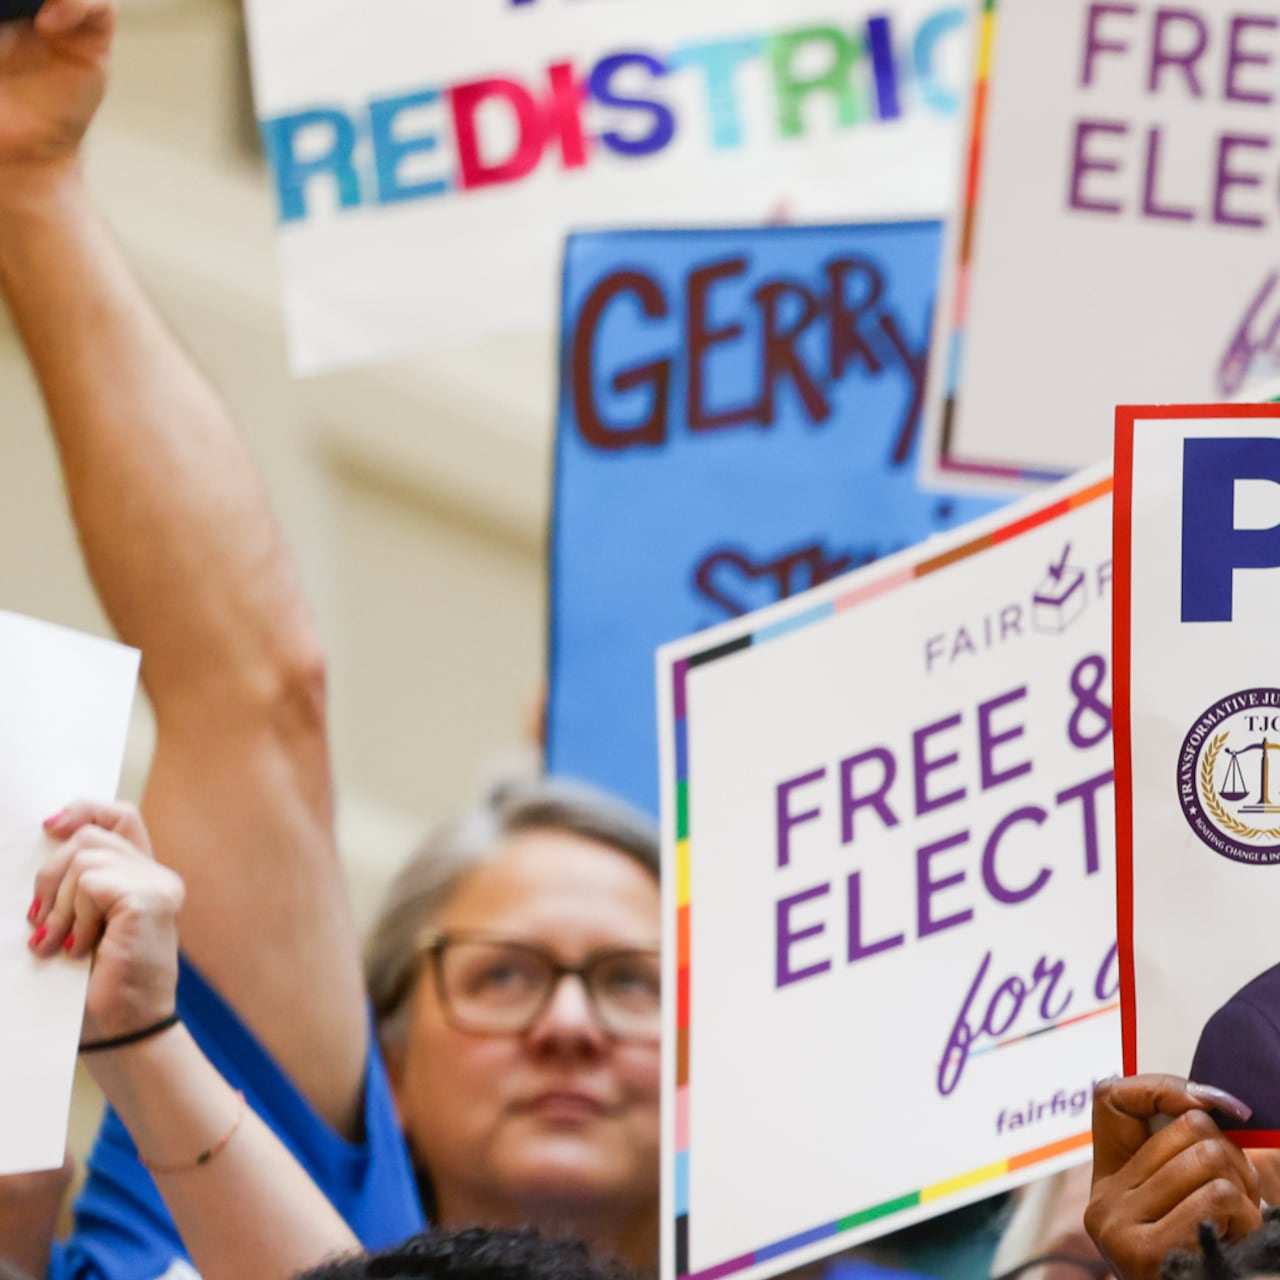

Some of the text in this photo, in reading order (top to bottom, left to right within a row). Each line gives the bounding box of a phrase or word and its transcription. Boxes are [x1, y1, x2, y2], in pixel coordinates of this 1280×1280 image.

[923, 602, 1026, 674] FAIR
[774, 653, 1114, 869] FREE &
[1181, 693, 1259, 804] TRANSFORMATIVE
[936, 949, 1074, 1097] for
